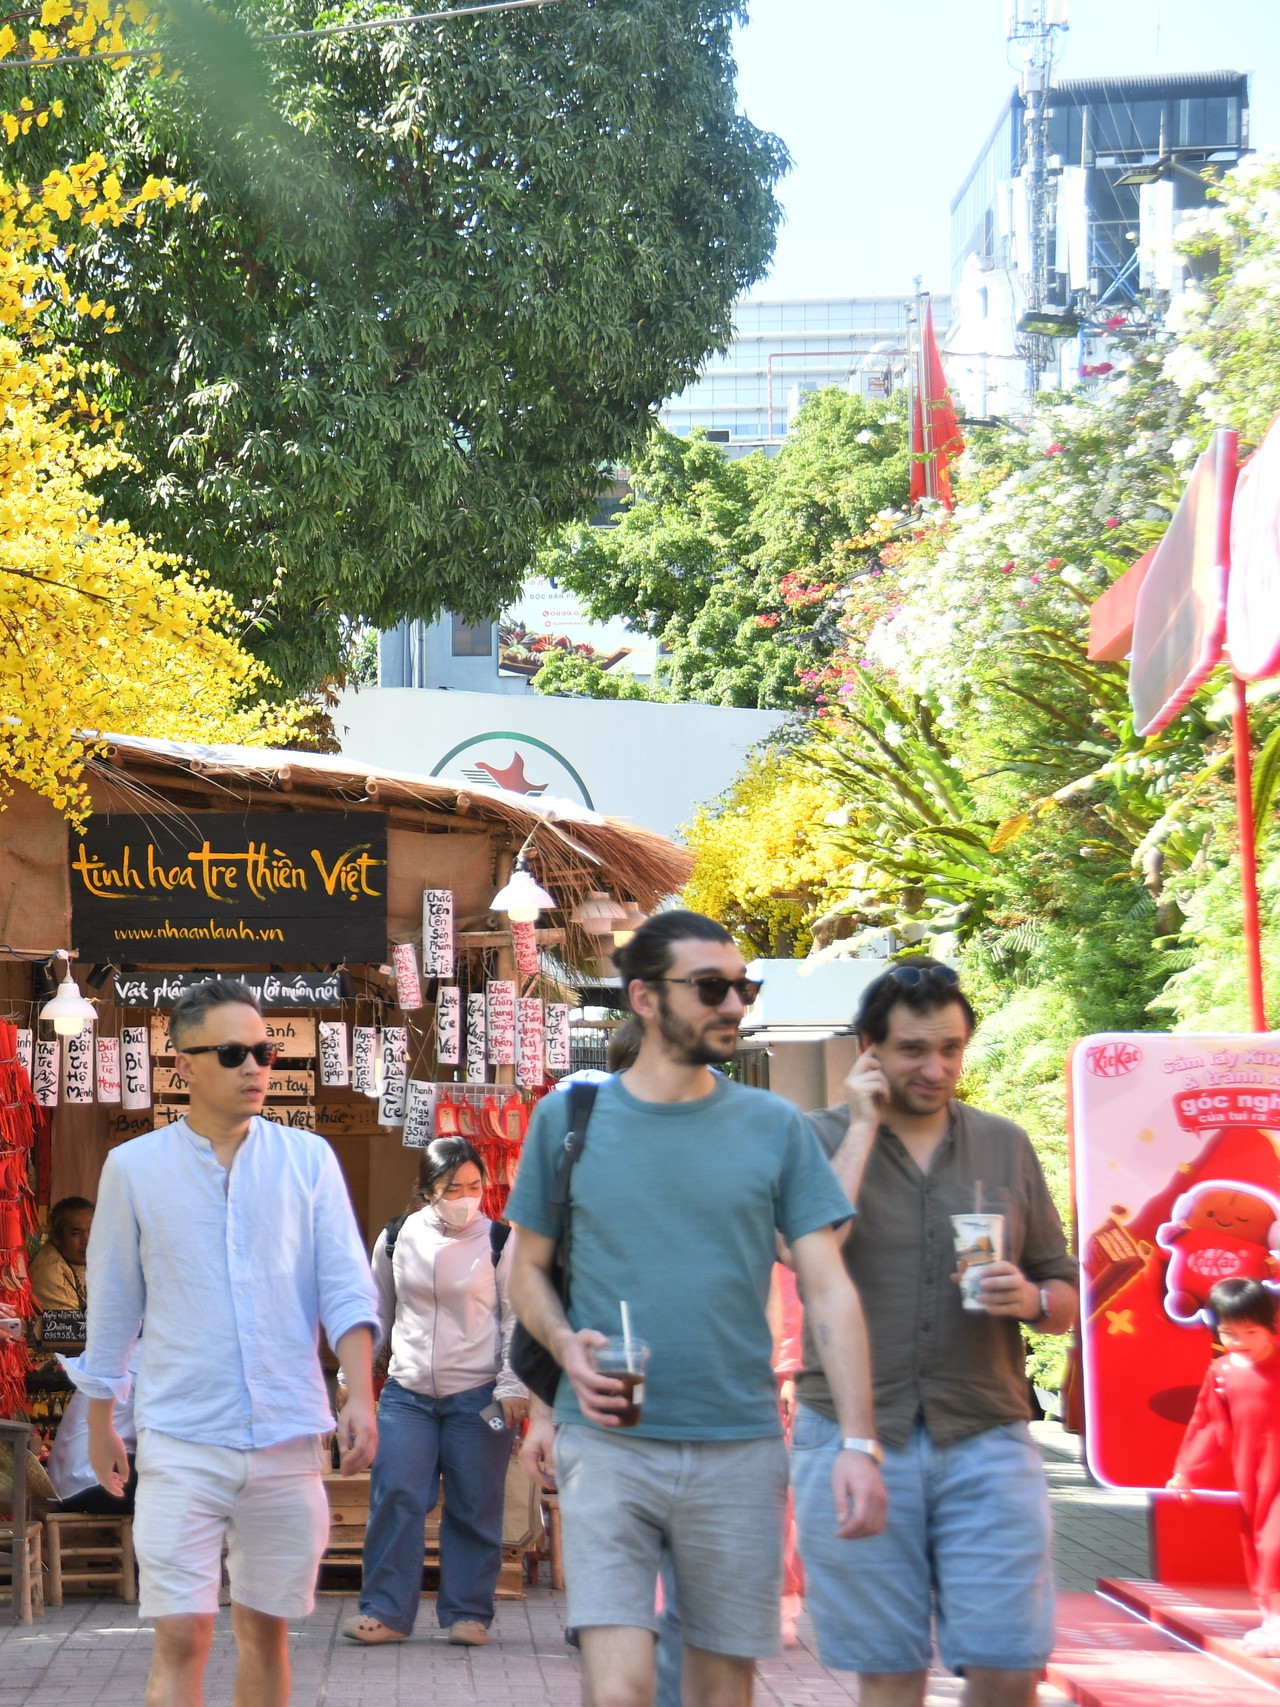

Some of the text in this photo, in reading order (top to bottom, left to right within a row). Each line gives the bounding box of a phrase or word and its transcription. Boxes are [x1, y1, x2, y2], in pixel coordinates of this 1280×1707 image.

[147, 844, 197, 890] hoa
[246, 841, 308, 901] thiền
[311, 843, 387, 901] Việt
[114, 919, 285, 942] www.nhaanlanh.vn
[123, 1028, 146, 1044] Bút
[68, 1040, 90, 1055] Bội
[97, 1039, 119, 1052] Bút
[38, 1055, 53, 1068] tre
[101, 1052, 114, 1063] Bi
[125, 1052, 142, 1071] Bi
[323, 1051, 339, 1060] tre
[383, 1046, 407, 1063] Bút
[1088, 1044, 1139, 1076] KitKat
[70, 1056, 89, 1070] Tre
[126, 1074, 146, 1094] Tre
[286, 1075, 309, 1095] tay
[1183, 1073, 1199, 1090] &
[413, 1096, 428, 1106] Tre
[1181, 1092, 1229, 1116] góc
[1198, 1110, 1267, 1122] của tui ra
